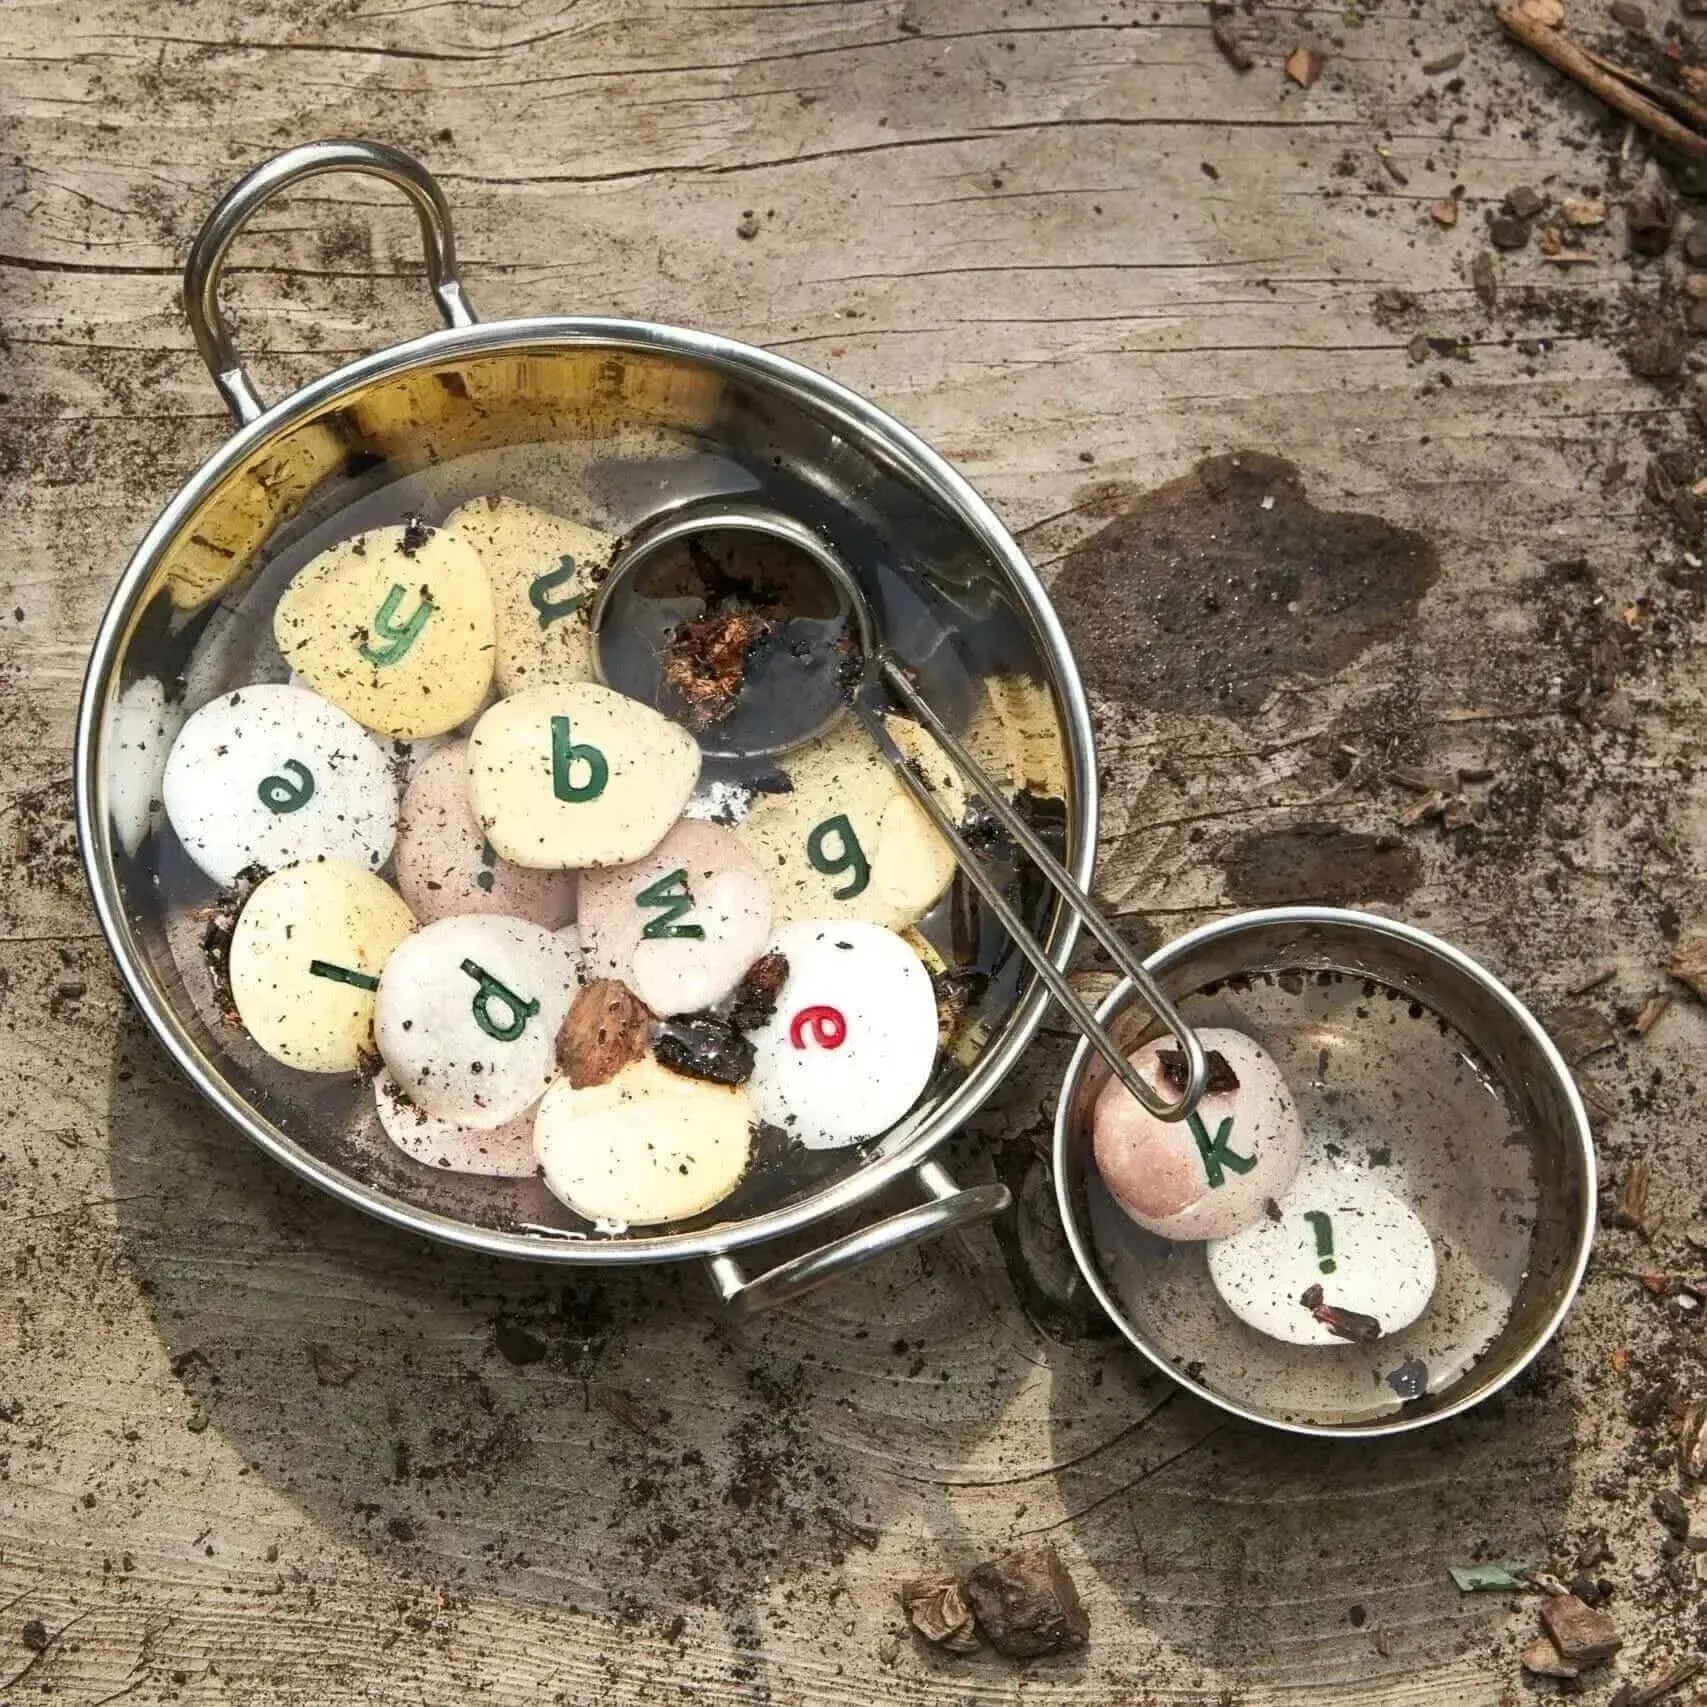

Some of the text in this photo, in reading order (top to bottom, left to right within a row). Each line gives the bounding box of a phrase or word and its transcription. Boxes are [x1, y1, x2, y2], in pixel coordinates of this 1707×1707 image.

[359, 584, 433, 667] y
[550, 715, 609, 803] b
[807, 813, 871, 899] g
[460, 957, 540, 1042] d
[790, 1005, 847, 1050] e
[1186, 1112, 1258, 1189] k
